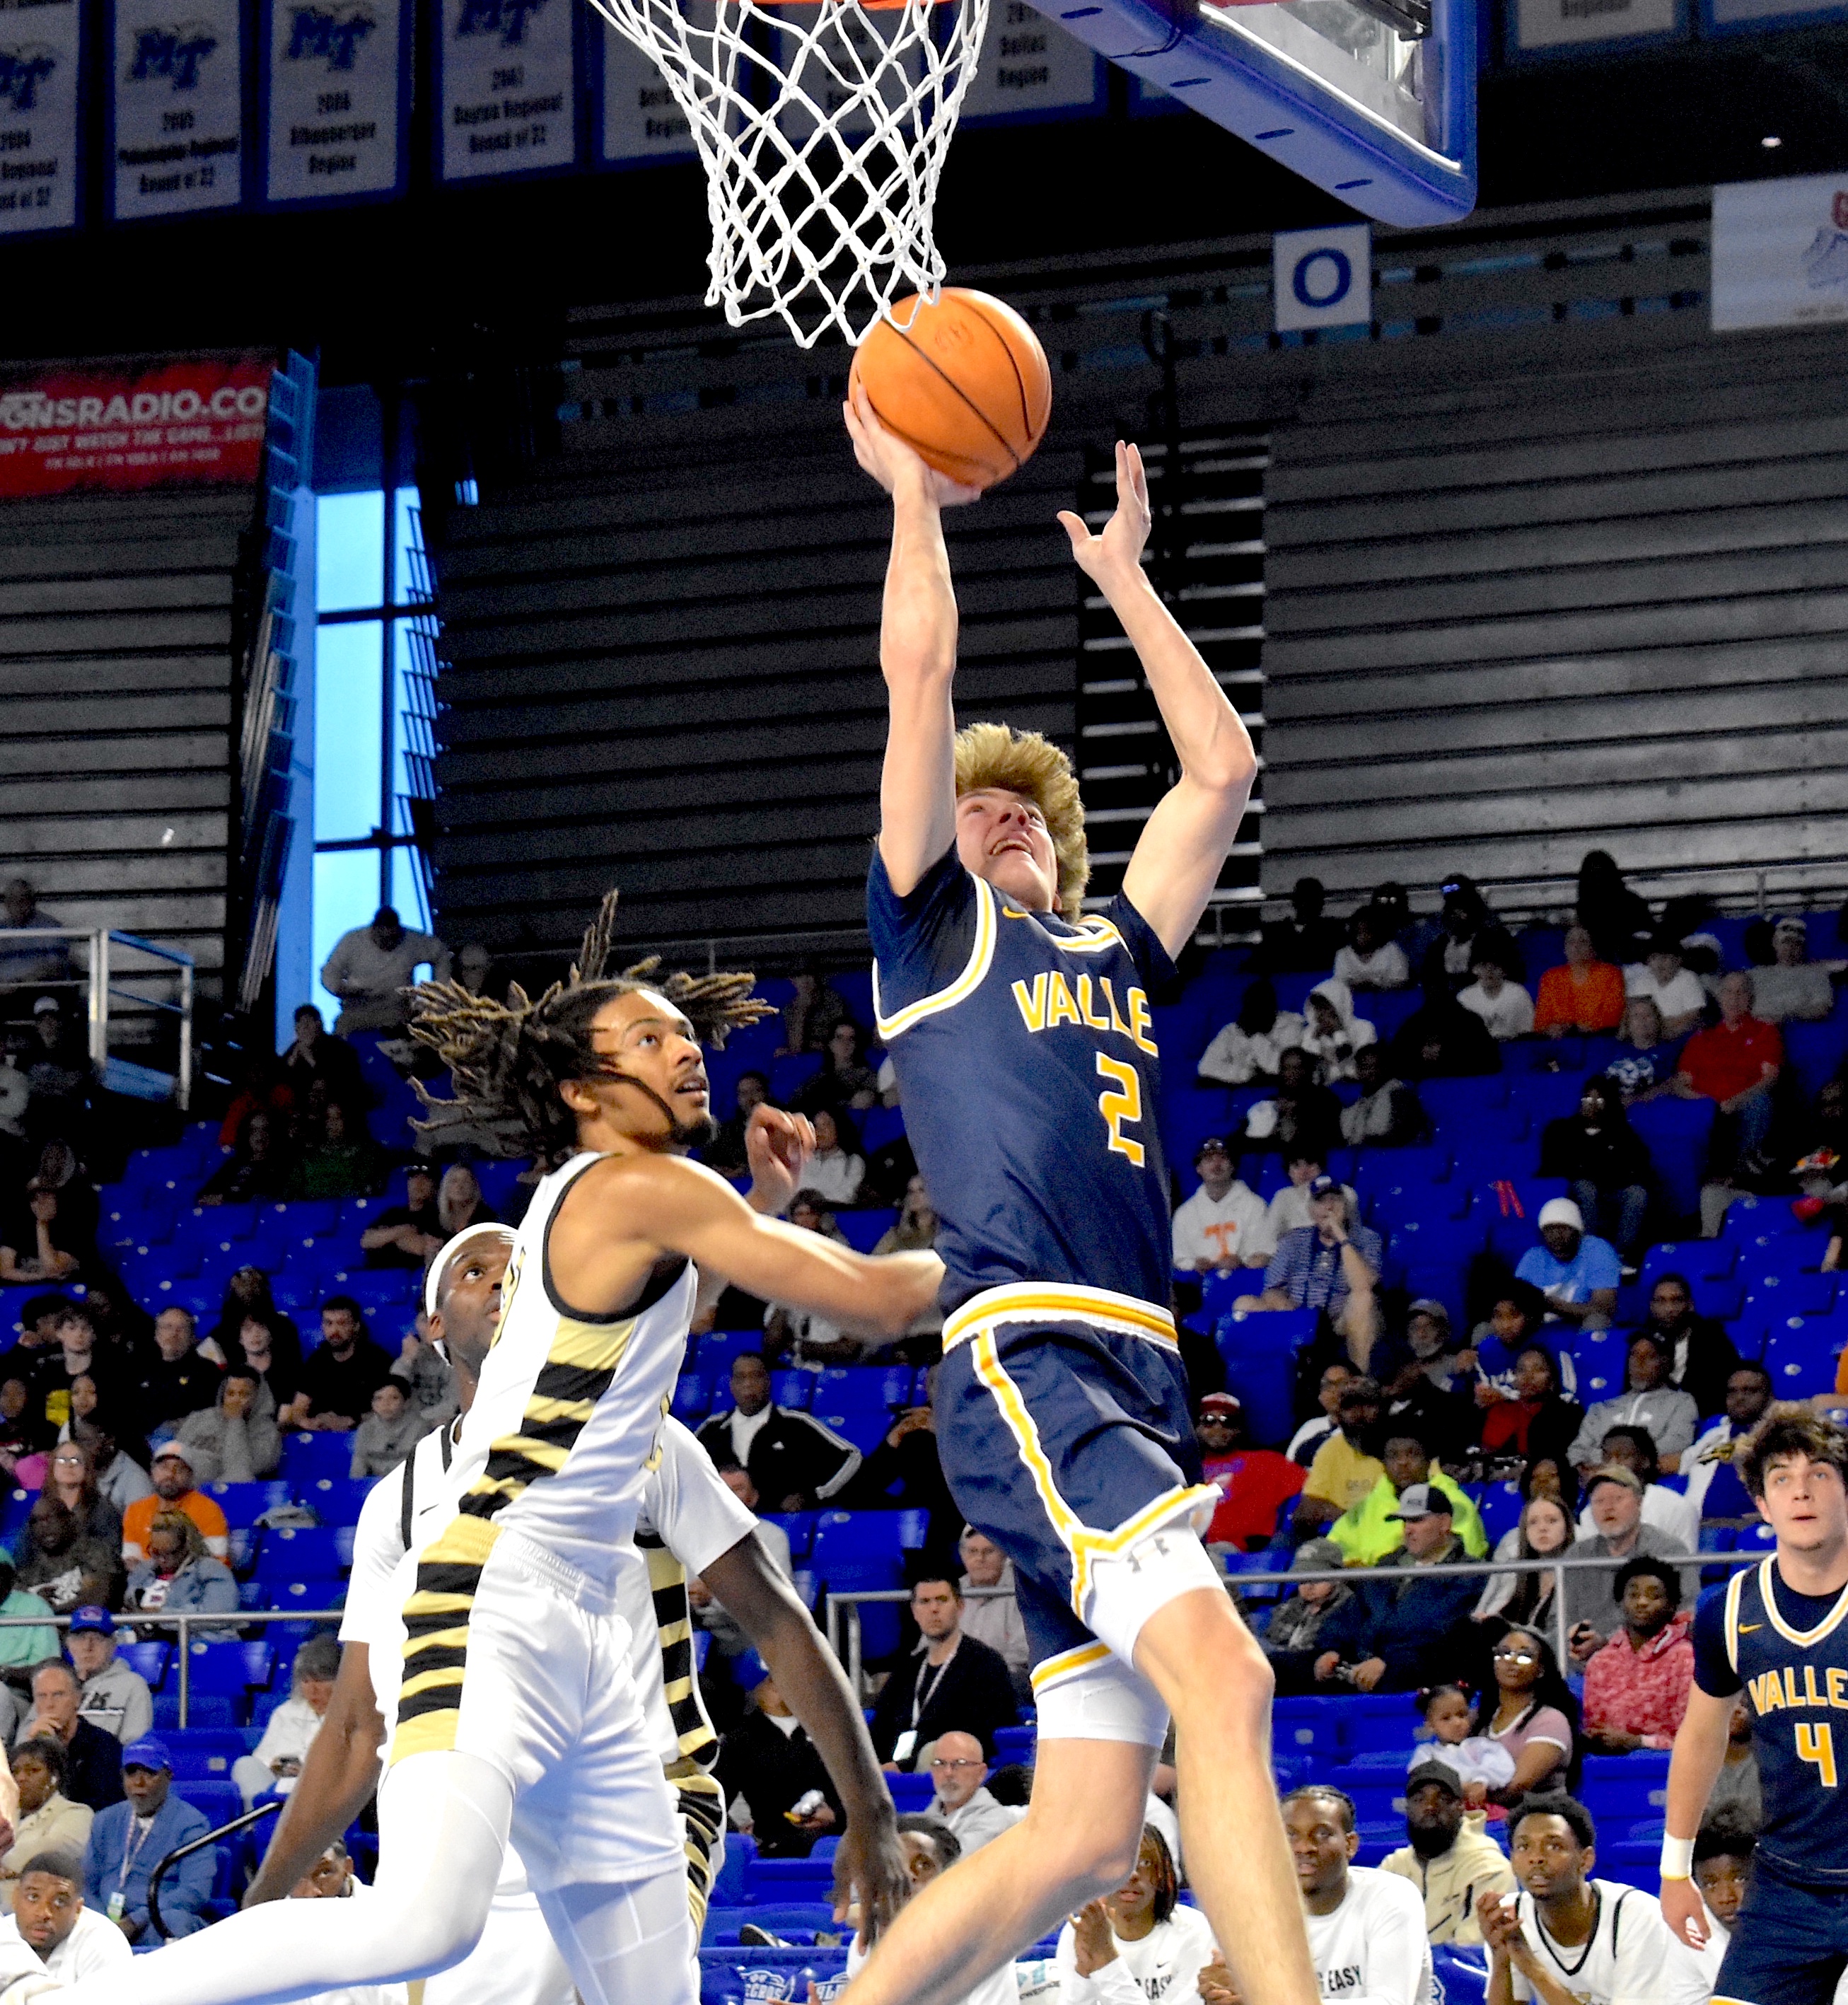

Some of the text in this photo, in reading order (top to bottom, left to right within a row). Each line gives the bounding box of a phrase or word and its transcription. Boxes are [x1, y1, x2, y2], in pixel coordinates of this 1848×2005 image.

[128, 28, 217, 91] MT
[282, 6, 377, 71] MT
[1292, 248, 1352, 308] O
[1011, 970, 1158, 1058] VALLE
[1096, 1051, 1145, 1168] 2
[1204, 1221, 1237, 1262] T
[1748, 1666, 1848, 1716] VALLE
[1794, 1723, 1838, 1787] 4
[1328, 1965, 1361, 1992] EASY
